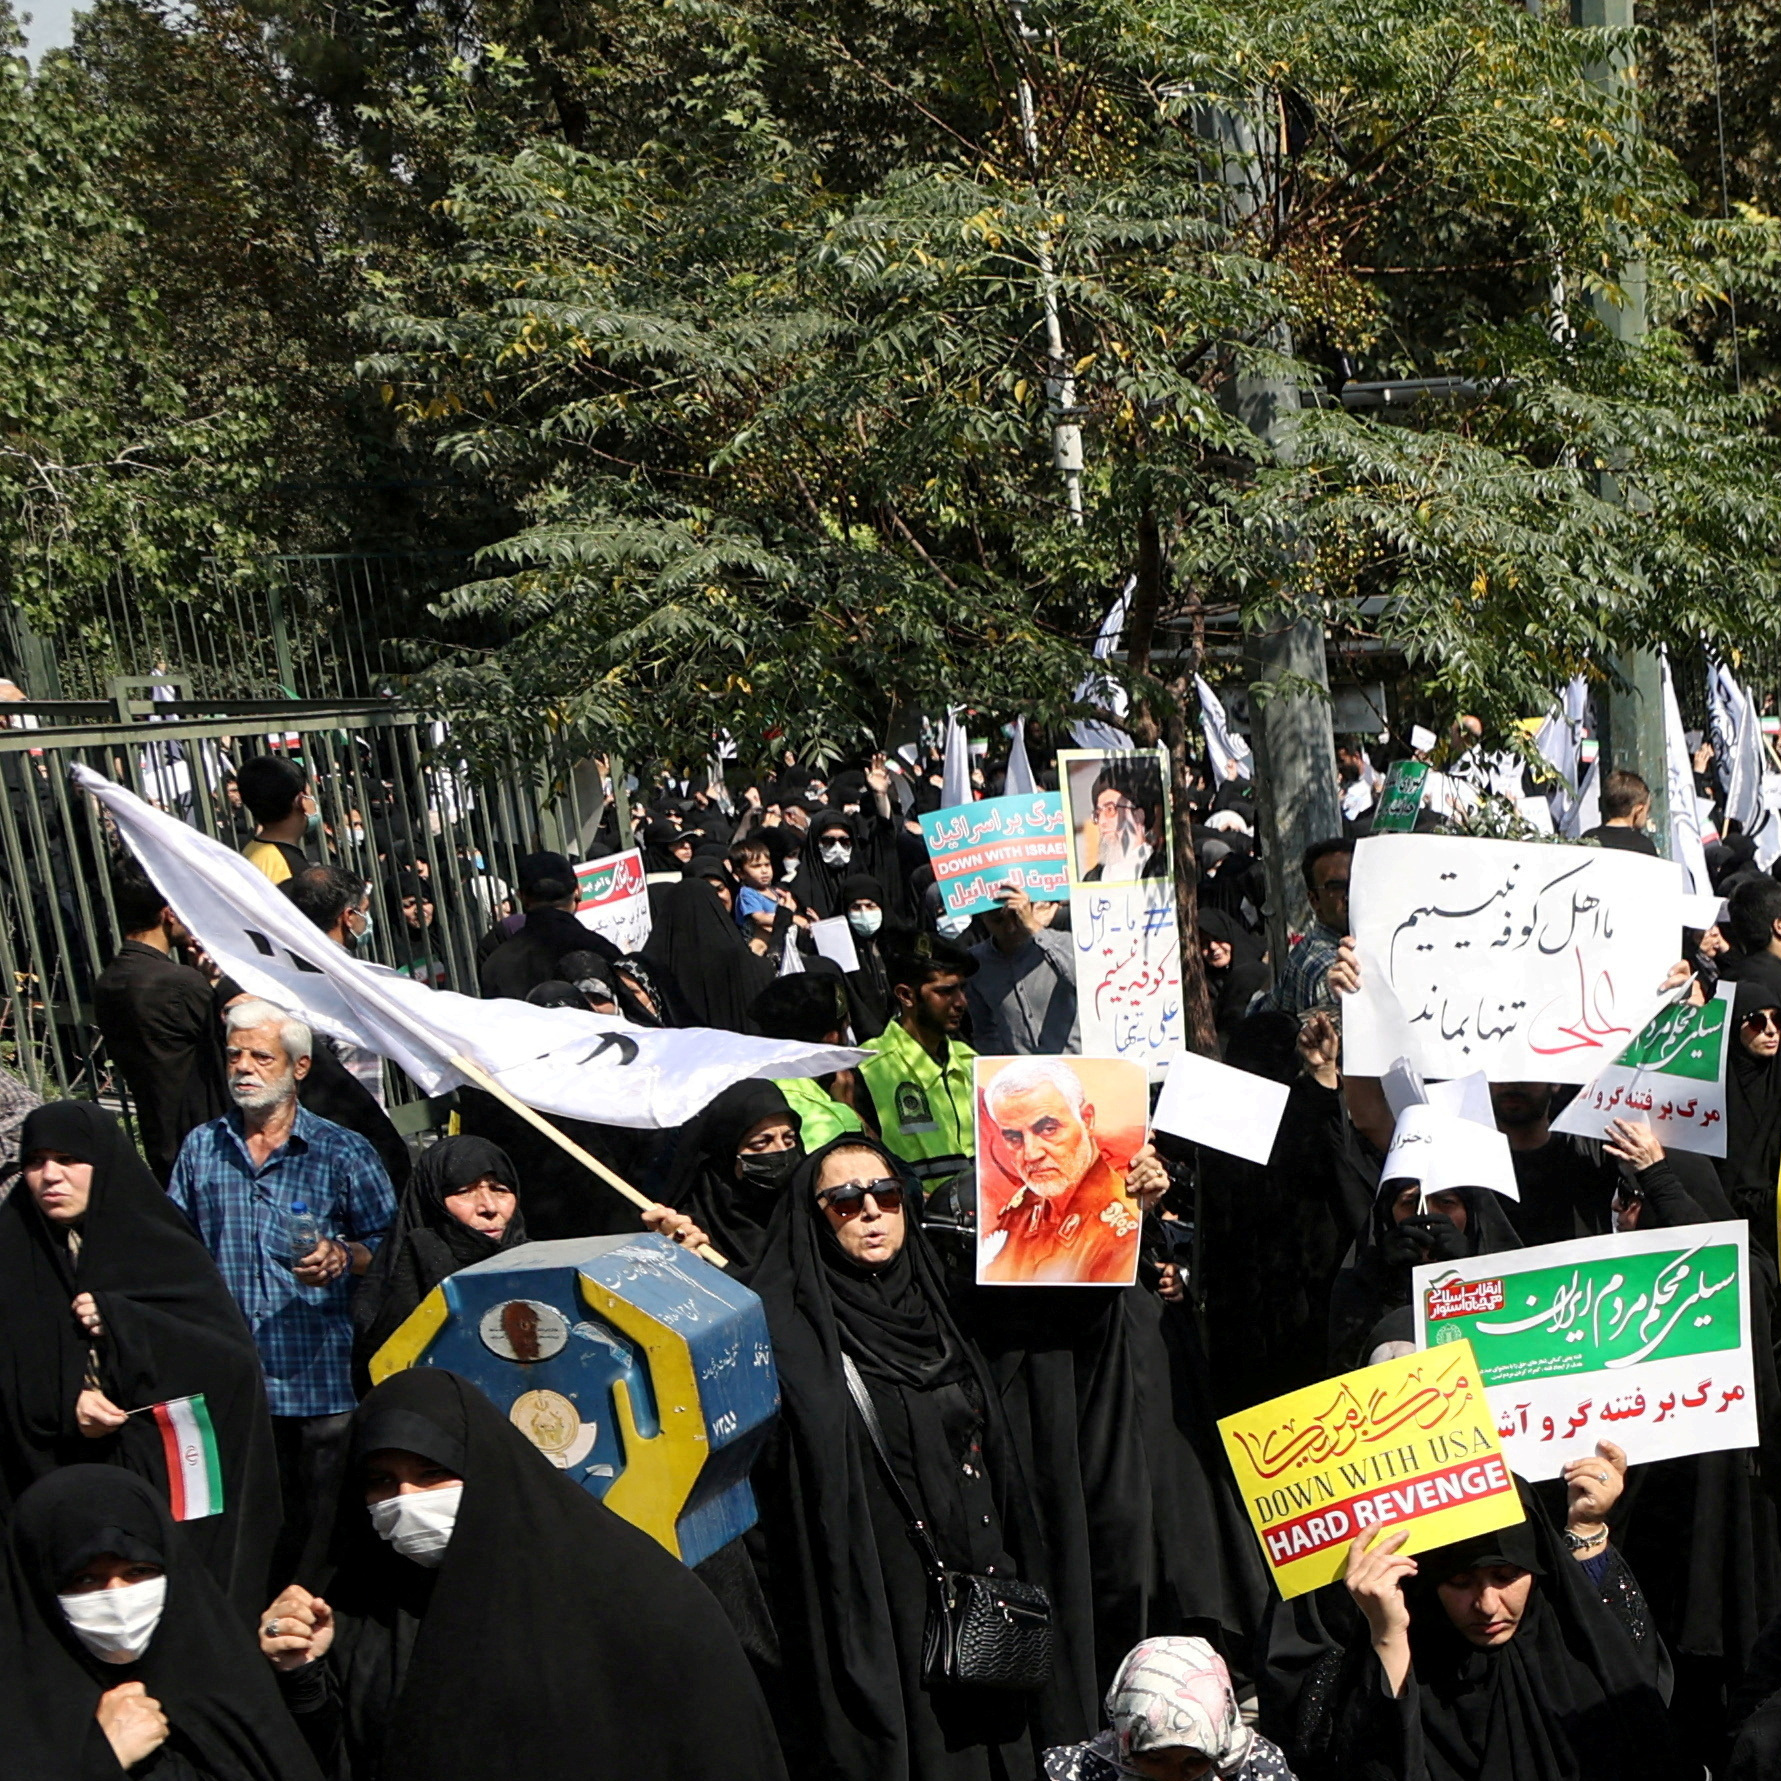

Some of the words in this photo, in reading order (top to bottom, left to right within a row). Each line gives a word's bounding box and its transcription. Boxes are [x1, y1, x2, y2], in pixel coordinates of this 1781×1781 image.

[928, 808, 1001, 850] اسرائیل
[937, 853, 984, 876] DOWN
[985, 845, 1023, 865] WITH
[1489, 857, 1597, 953] کوفه
[1389, 862, 1525, 990] نیستیم
[1408, 984, 1473, 1056] بماند
[1475, 995, 1527, 1044] تنها
[1624, 1087, 1653, 1112] فتنه
[1656, 1100, 1674, 1121] بر
[1676, 1098, 1721, 1128] مرگ
[1599, 1385, 1647, 1422] فتنه
[1652, 1389, 1676, 1424] بر
[1681, 1377, 1746, 1414] مرگ
[1539, 1413, 1556, 1442] و
[1561, 1398, 1593, 1440] گر
[1253, 1471, 1334, 1524] DOWN
[1338, 1444, 1421, 1490] WITH
[1428, 1425, 1494, 1464] USA
[1266, 1509, 1349, 1561] HARD
[1352, 1459, 1510, 1527] REVENGE
